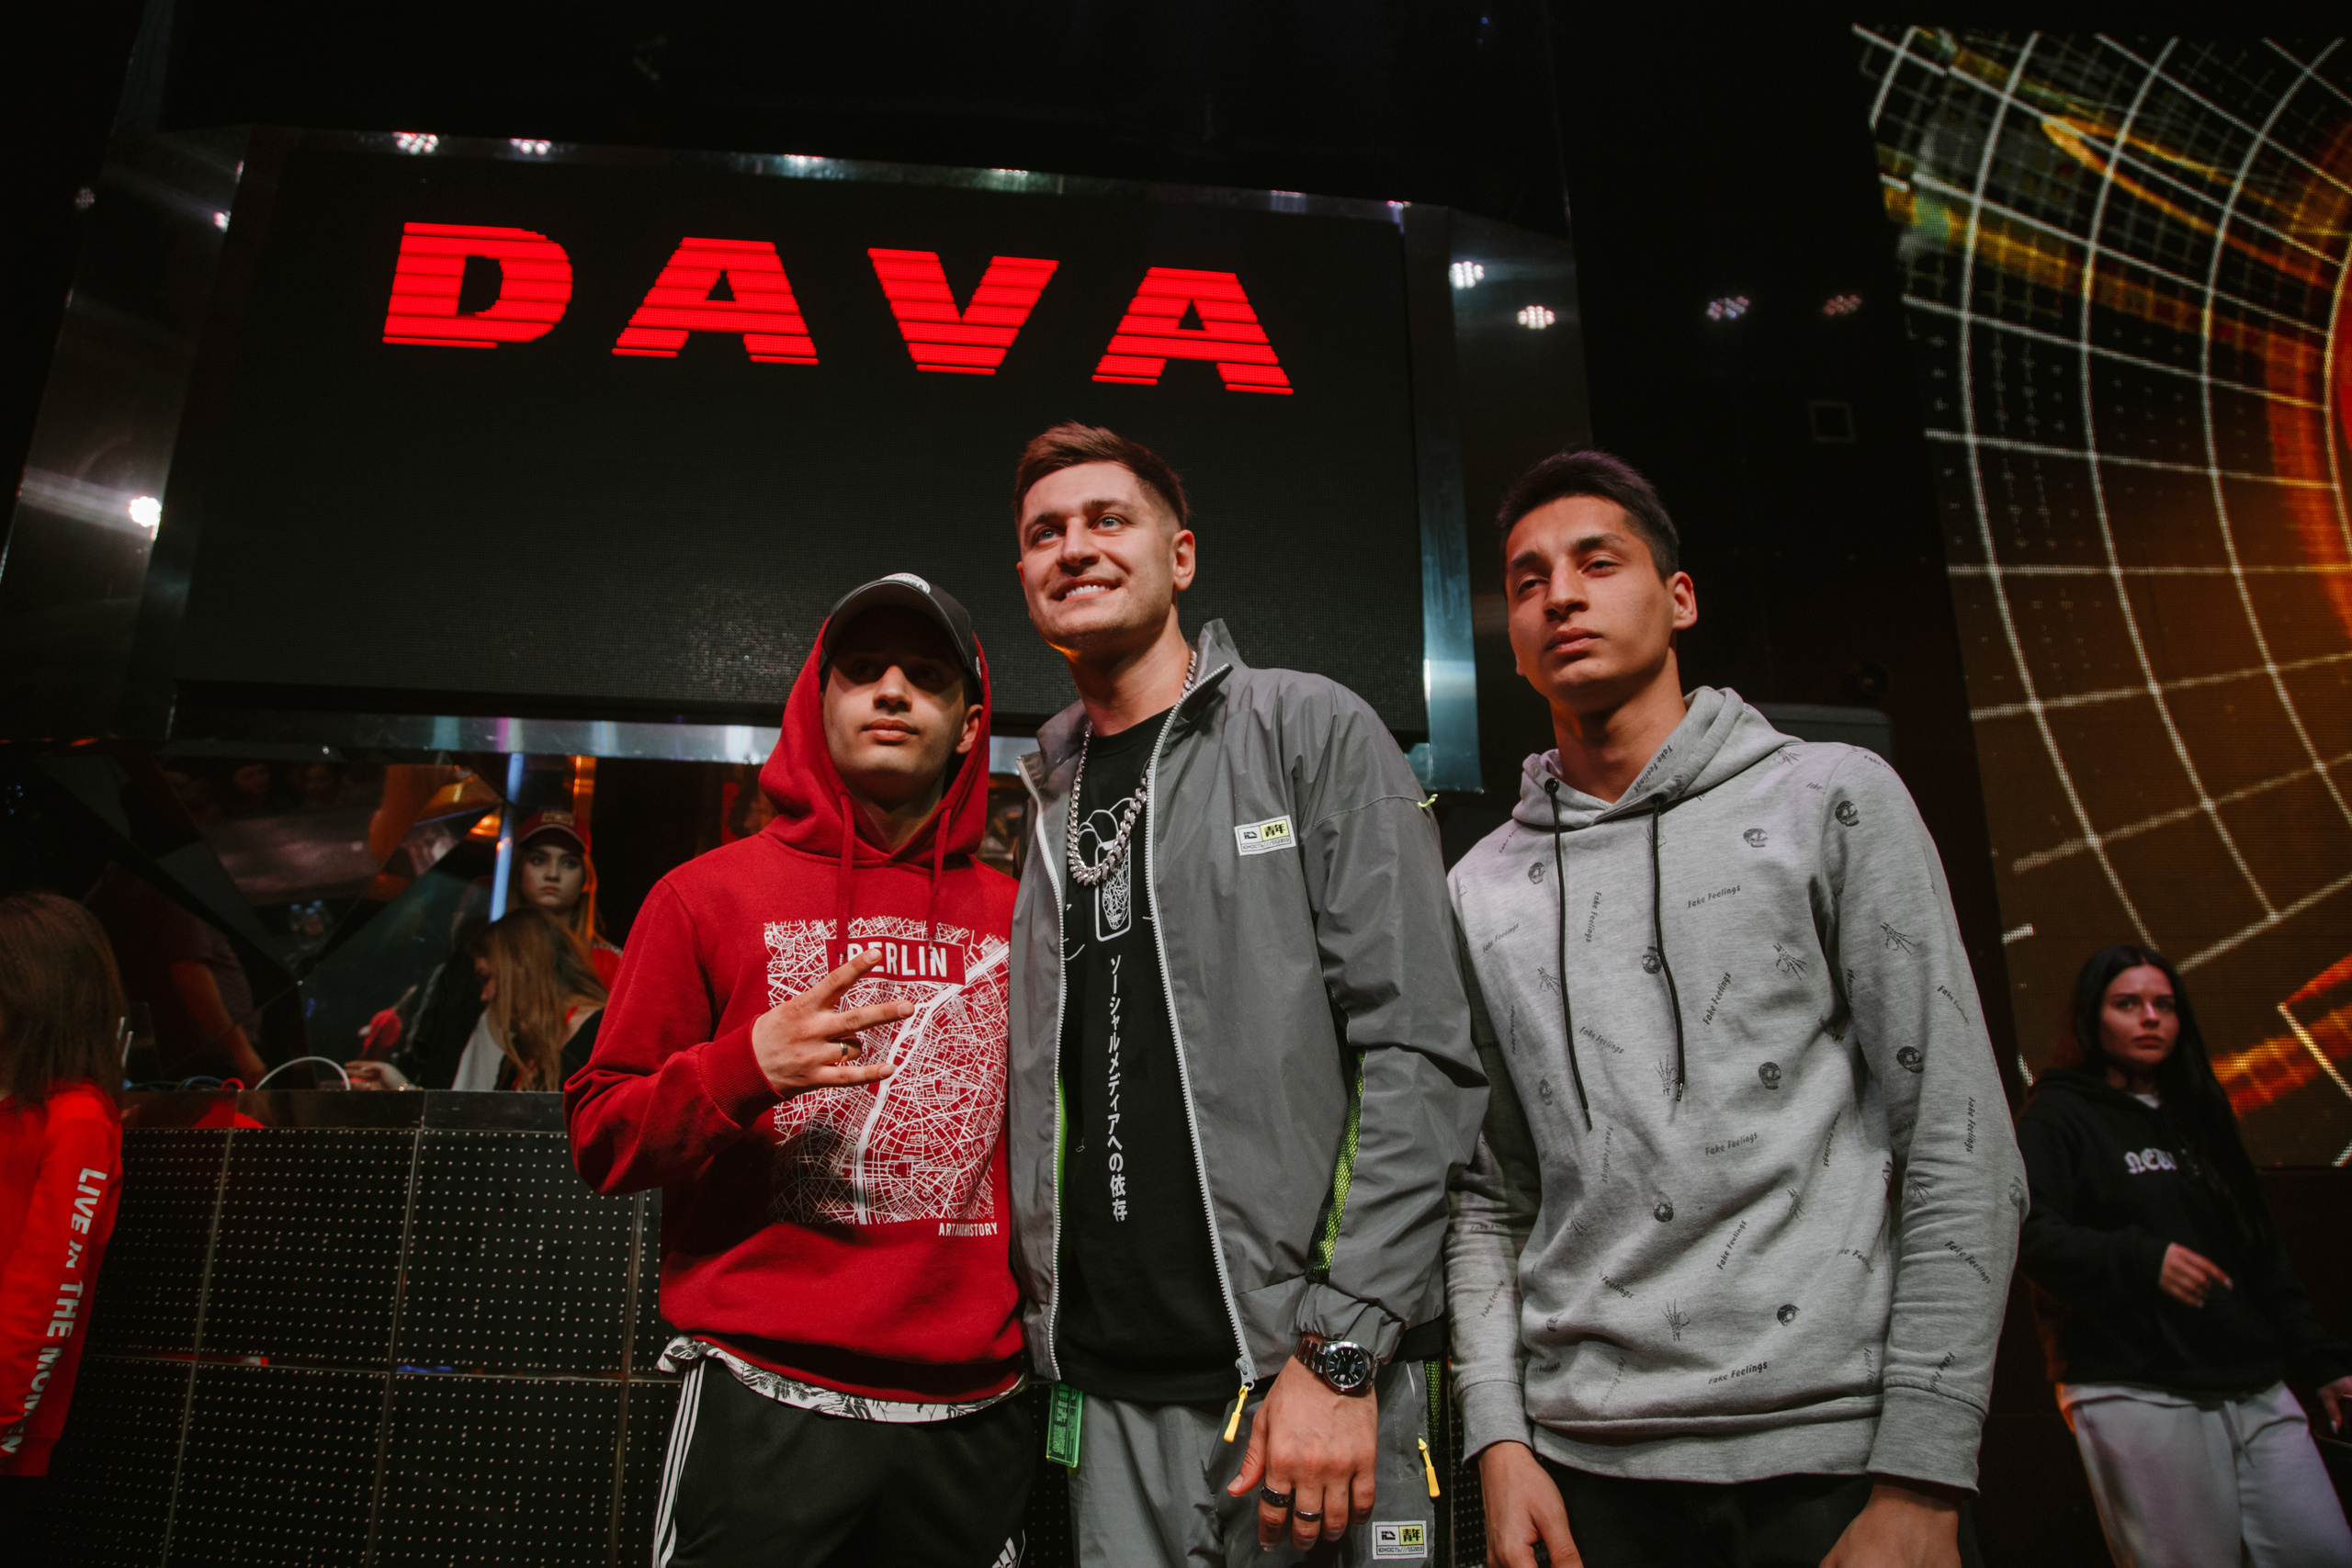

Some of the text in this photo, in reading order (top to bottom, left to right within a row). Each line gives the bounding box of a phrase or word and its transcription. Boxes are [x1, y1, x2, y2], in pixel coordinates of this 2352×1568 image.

[382, 222, 1294, 395] DAVA
[1634, 745, 1673, 793] Fake Feelings
[1585, 891, 1602, 943] Fake Feelings
[1688, 885, 1741, 908] Fake Feelings
[1702, 971, 1732, 1026] Fake Feelings
[1938, 985, 1954, 1000] Fake
[1578, 1026, 1625, 1055] Fake Feelings
[1106, 954, 1128, 1223] ソーシャルメディアへの依存
[1705, 1132, 1758, 1156] Fake Feelings
[1963, 1097, 1976, 1154] Fake Feelings
[1823, 1133, 1835, 1168] Feelings
[71, 1168, 107, 1235] LIVE
[1716, 1220, 1747, 1270] Fake Feelings
[1945, 1240, 1992, 1284] Fake Feelings
[47, 1280, 84, 1338] THE
[1600, 1275, 1634, 1299] Feelings
[1708, 1361, 1768, 1385] Fake Feelings
[1864, 1348, 1874, 1370] Fake
[1938, 1351, 1955, 1371] Fake
[0, 1347, 62, 1454] MOMEN
